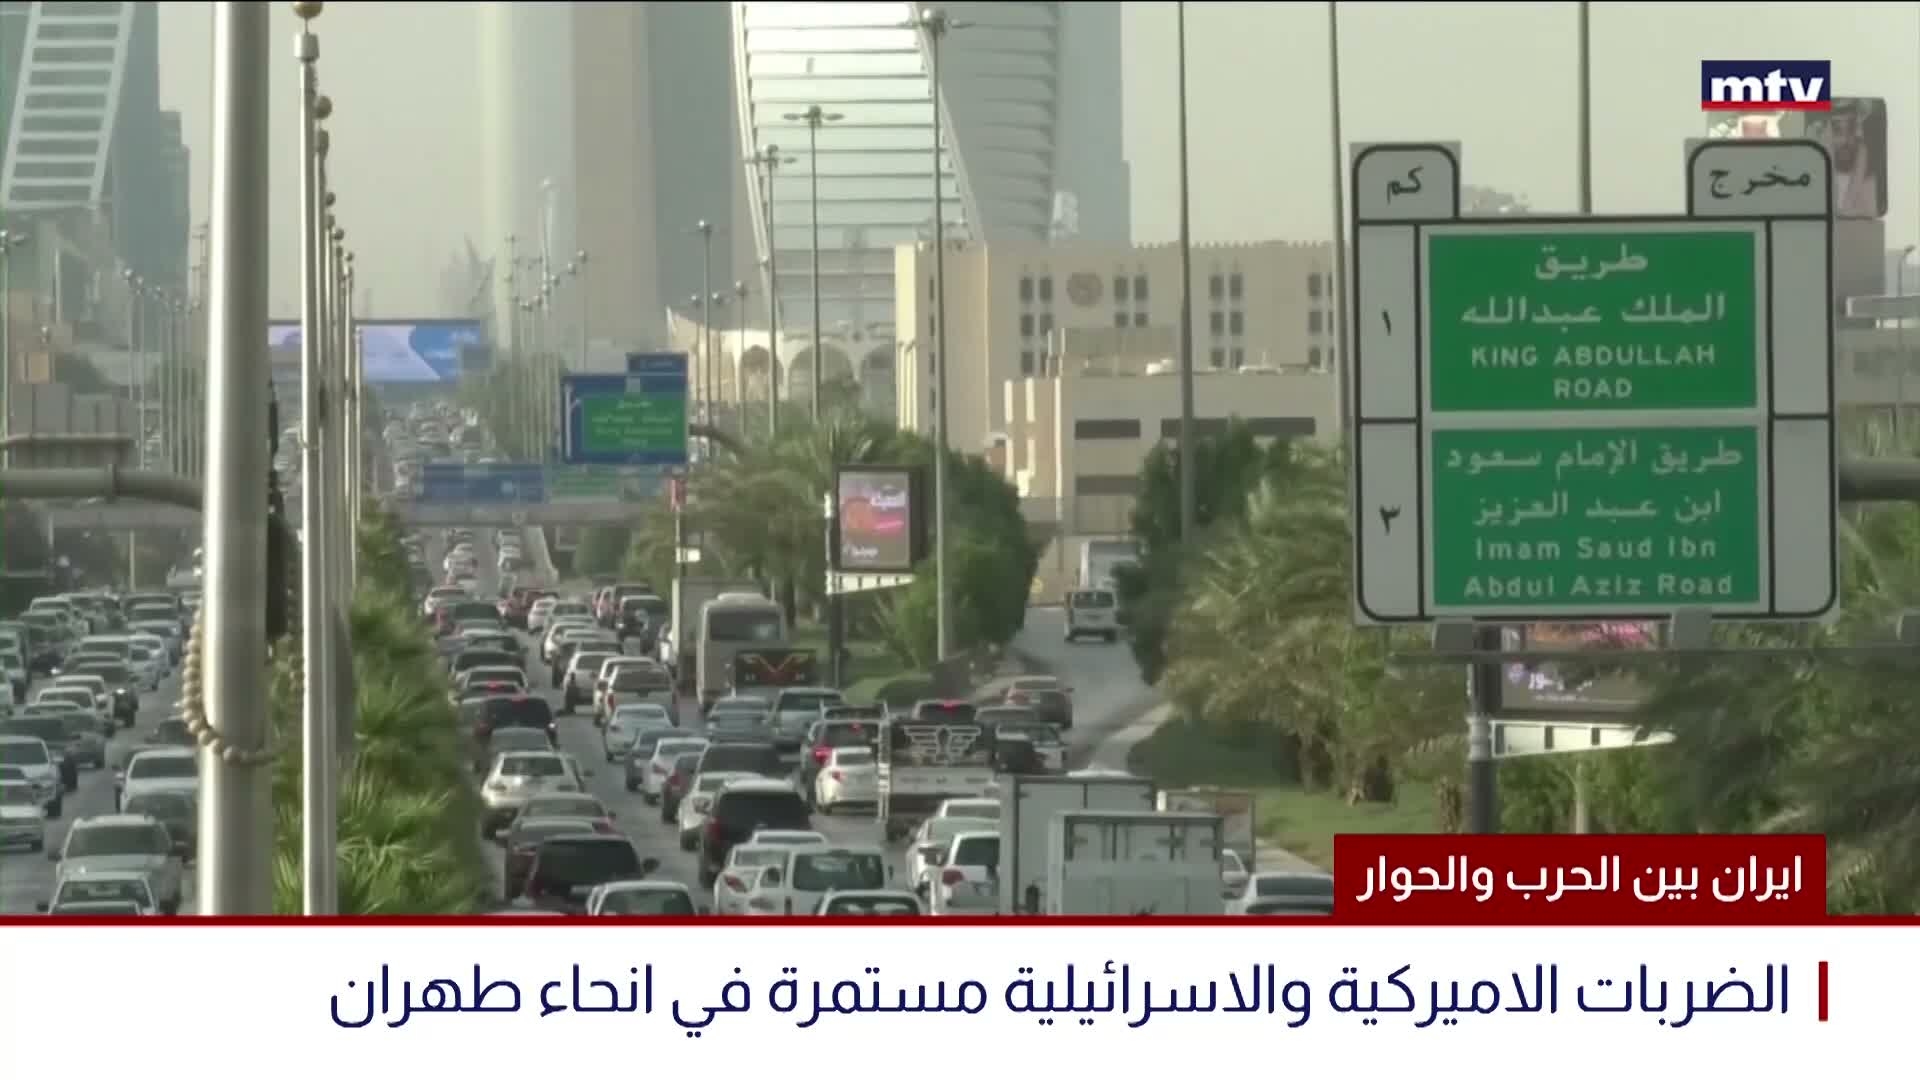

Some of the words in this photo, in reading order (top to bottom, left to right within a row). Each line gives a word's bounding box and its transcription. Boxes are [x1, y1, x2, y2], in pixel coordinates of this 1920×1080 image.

[1387, 167, 1423, 204] كم
[1709, 165, 1811, 199] مخرج
[1535, 242, 1649, 281] طريق
[1621, 293, 1726, 325] الملك
[1471, 345, 1538, 368] KING
[1553, 343, 1716, 367] ABDULLAH
[1553, 377, 1633, 400] ROAD
[1447, 448, 1542, 476] سعود
[1652, 438, 1743, 475] طريق
[1473, 490, 1569, 527] العزيز
[1585, 498, 1658, 524] عبد
[1674, 489, 1721, 524] ابن
[1476, 537, 1561, 561] Imam
[1577, 536, 1653, 560] Saud
[1668, 535, 1717, 558] Ibn
[1463, 574, 1555, 599] Abdul
[1569, 574, 1642, 597] Aziz
[1657, 572, 1733, 596] Road
